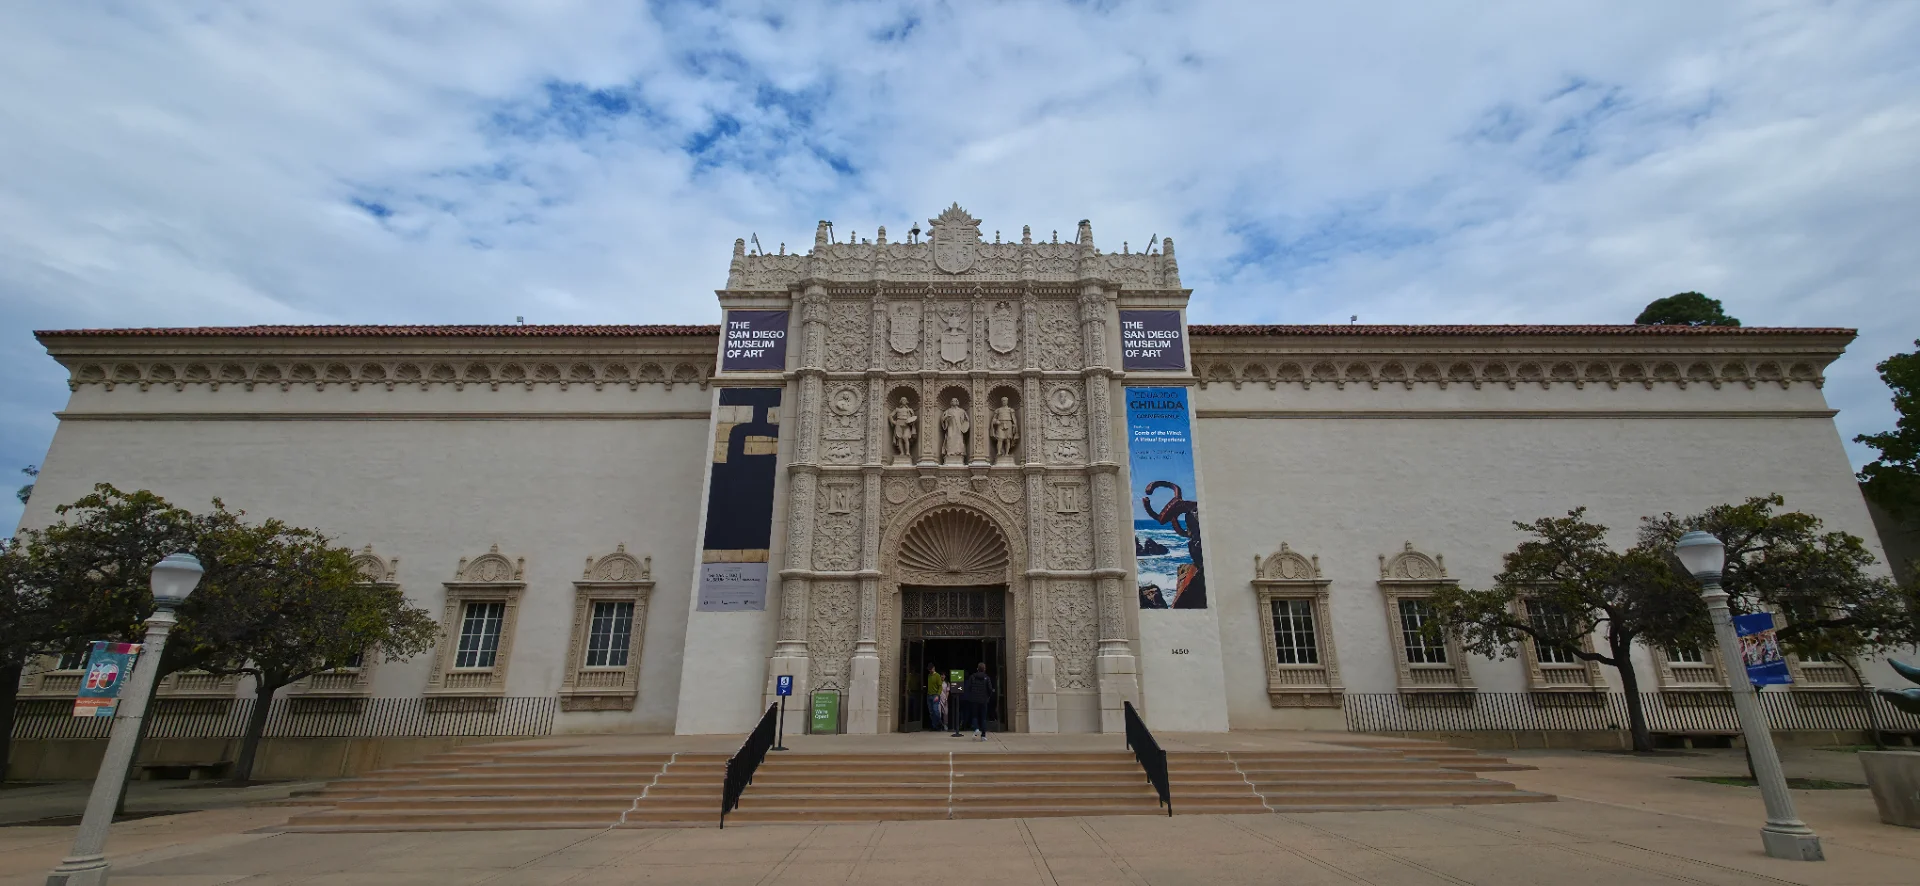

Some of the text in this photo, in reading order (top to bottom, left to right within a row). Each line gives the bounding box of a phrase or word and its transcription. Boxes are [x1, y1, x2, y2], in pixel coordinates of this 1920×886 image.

[730, 321, 750, 329] THE
[1122, 321, 1143, 329] THE
[728, 330, 785, 339] SAN DIEGO
[1124, 330, 1179, 339] SAN DIEGO
[727, 340, 775, 348] MUSEUM
[1124, 340, 1171, 348] MUSEUM
[727, 349, 765, 358] OF ART
[1125, 349, 1162, 358] OF ART
[1134, 391, 1178, 399] EDUARDO
[1130, 400, 1185, 410] CHILLIDA
